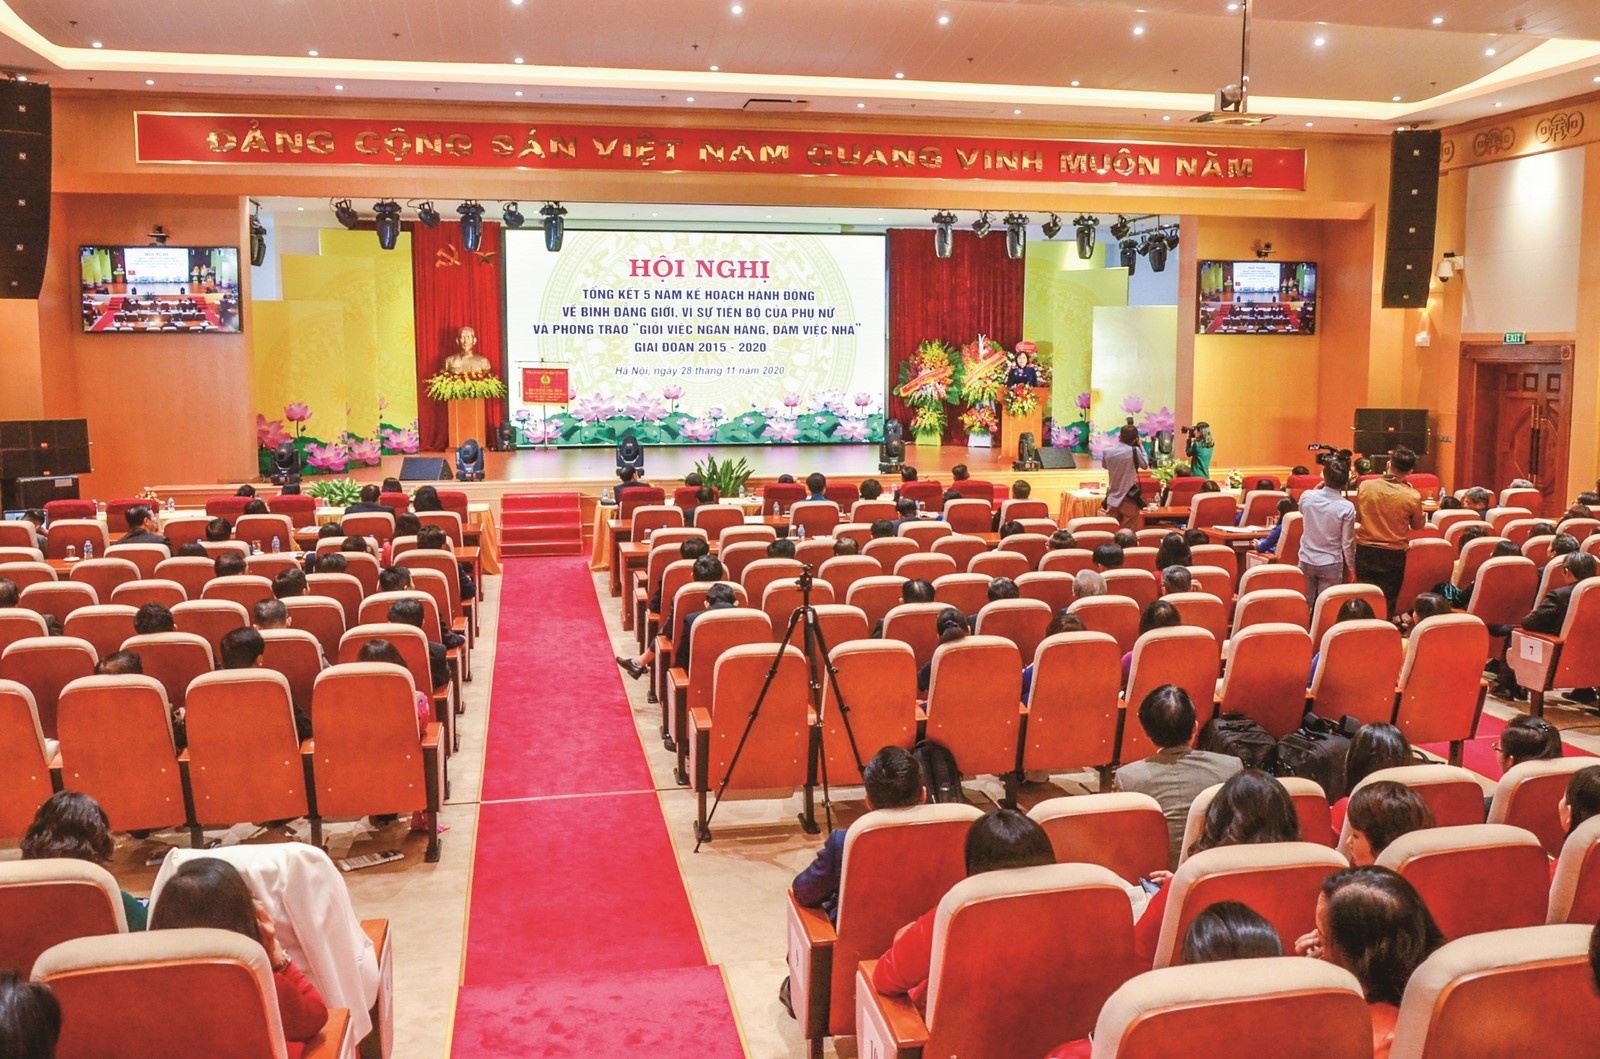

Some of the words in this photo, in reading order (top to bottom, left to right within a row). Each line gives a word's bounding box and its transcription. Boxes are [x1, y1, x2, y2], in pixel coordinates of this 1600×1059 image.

[206, 119, 335, 154] ĐẢNG
[354, 127, 472, 162] CỘNG
[491, 128, 576, 159] SẢN
[592, 131, 683, 166] VIỆT
[699, 139, 790, 164] NAM
[807, 143, 943, 169] QUANG
[955, 148, 1043, 173] VINH
[1059, 148, 1160, 177] MUÔN
[1175, 151, 1254, 179] NĂM
[628, 255, 685, 282] HỘI
[695, 260, 770, 283] NGHỊ
[582, 285, 614, 300] TỔNG
[618, 286, 640, 300] KẾT
[643, 290, 650, 300] 5
[655, 287, 682, 300] NĂM
[686, 286, 701, 300] KẾ
[705, 290, 744, 302] HOẠCH
[748, 288, 780, 300] HÀNH
[783, 289, 815, 302] ĐỘNG
[581, 305, 610, 317] BÌNH
[682, 305, 693, 317] VÌ
[697, 306, 713, 320] SỰ
[716, 304, 742, 318] TIẾN
[746, 306, 761, 320] BỘ
[765, 304, 788, 318] CỦA
[792, 308, 815, 321] PHỤ
[533, 322, 549, 334] VÀ
[552, 324, 594, 334] PHONG
[598, 322, 629, 334] TRÀO
[667, 323, 693, 337] VIỆC
[697, 323, 730, 335] NGÂN
[734, 323, 769, 336] HÀNG,
[803, 324, 828, 337] VIỆC
[1506, 333, 1521, 343] EXIT
[634, 342, 658, 352] GIAI
[662, 342, 694, 354] ĐOẠN
[698, 342, 726, 352] 2015
[738, 342, 767, 352] 2020
[615, 366, 628, 375] Hà
[631, 366, 650, 376] Nội,
[654, 366, 678, 376] ngày
[681, 366, 693, 375] 28
[695, 366, 723, 376] tháng
[726, 366, 735, 375] 11
[738, 366, 760, 375] năm
[762, 366, 785, 375] 2020
[1529, 645, 1534, 655] 7
